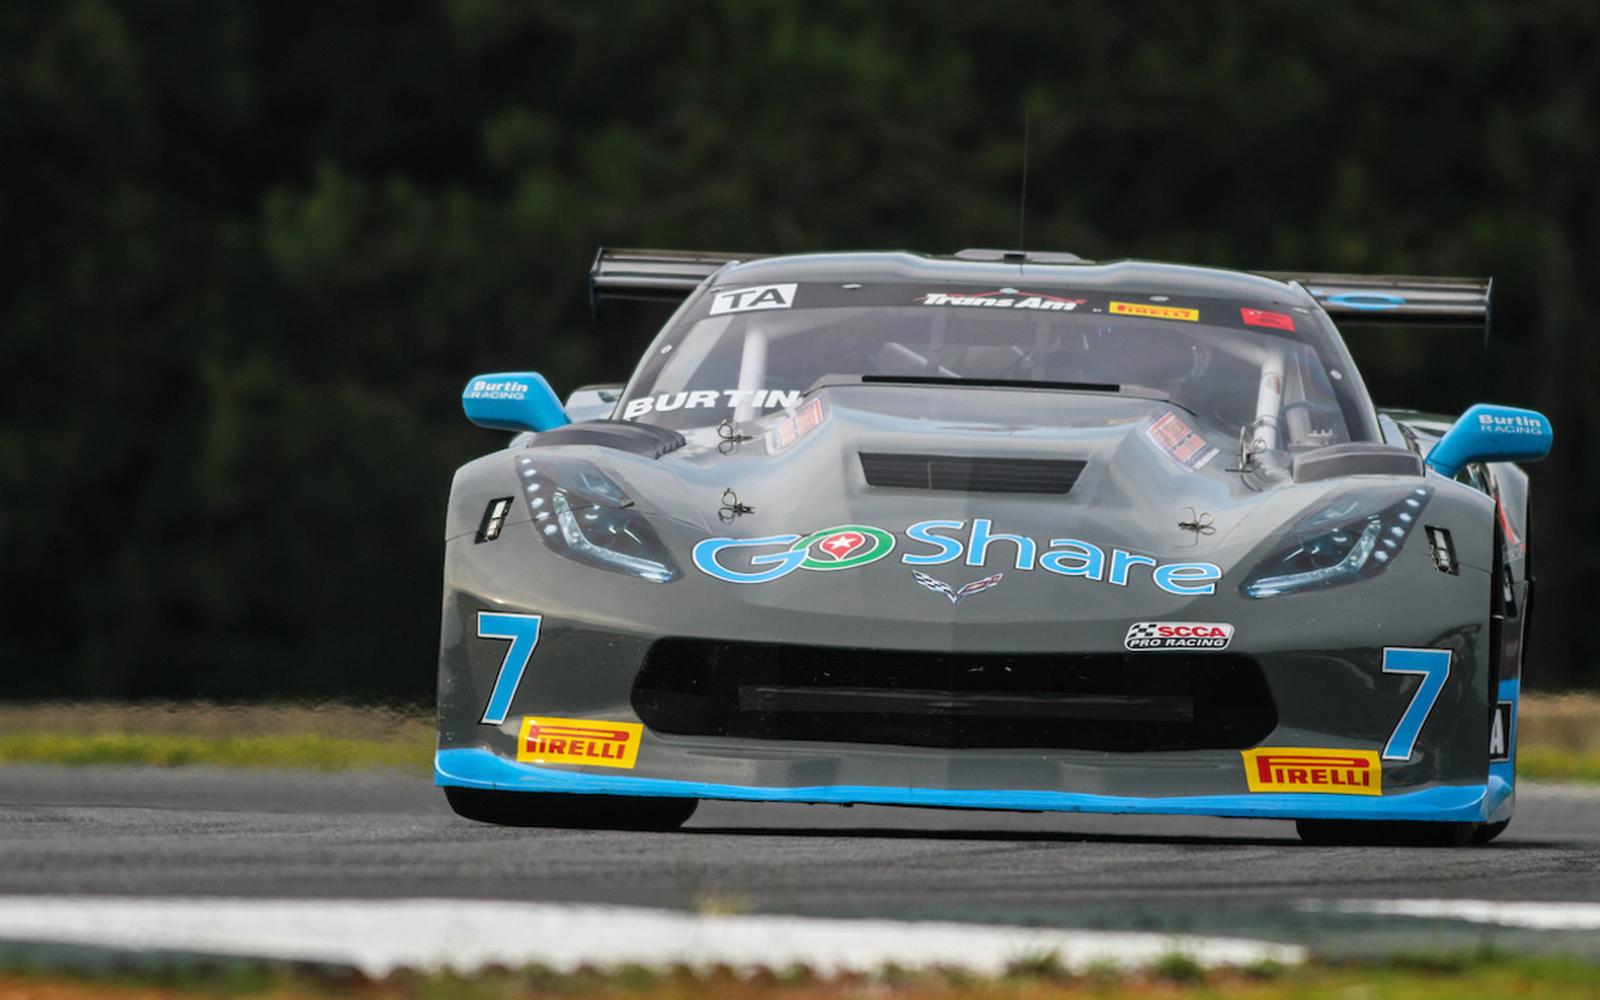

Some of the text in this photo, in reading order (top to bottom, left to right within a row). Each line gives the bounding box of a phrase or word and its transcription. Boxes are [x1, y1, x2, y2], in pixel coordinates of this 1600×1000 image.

[721, 288, 787, 309] TA
[923, 293, 1015, 308] Trans
[1014, 297, 1077, 311] Am
[472, 391, 524, 400] RACING
[473, 381, 528, 392] Burtin
[623, 389, 801, 421] BURTIN
[1478, 414, 1541, 427] Burtin
[1480, 425, 1542, 435] RACING
[1157, 625, 1227, 637] SCCA
[1129, 638, 1225, 648] PRO RACING
[477, 610, 543, 726] 7
[1380, 647, 1453, 762] 7
[526, 725, 630, 760] PIRELLI
[1256, 755, 1370, 787] PIRELLI
